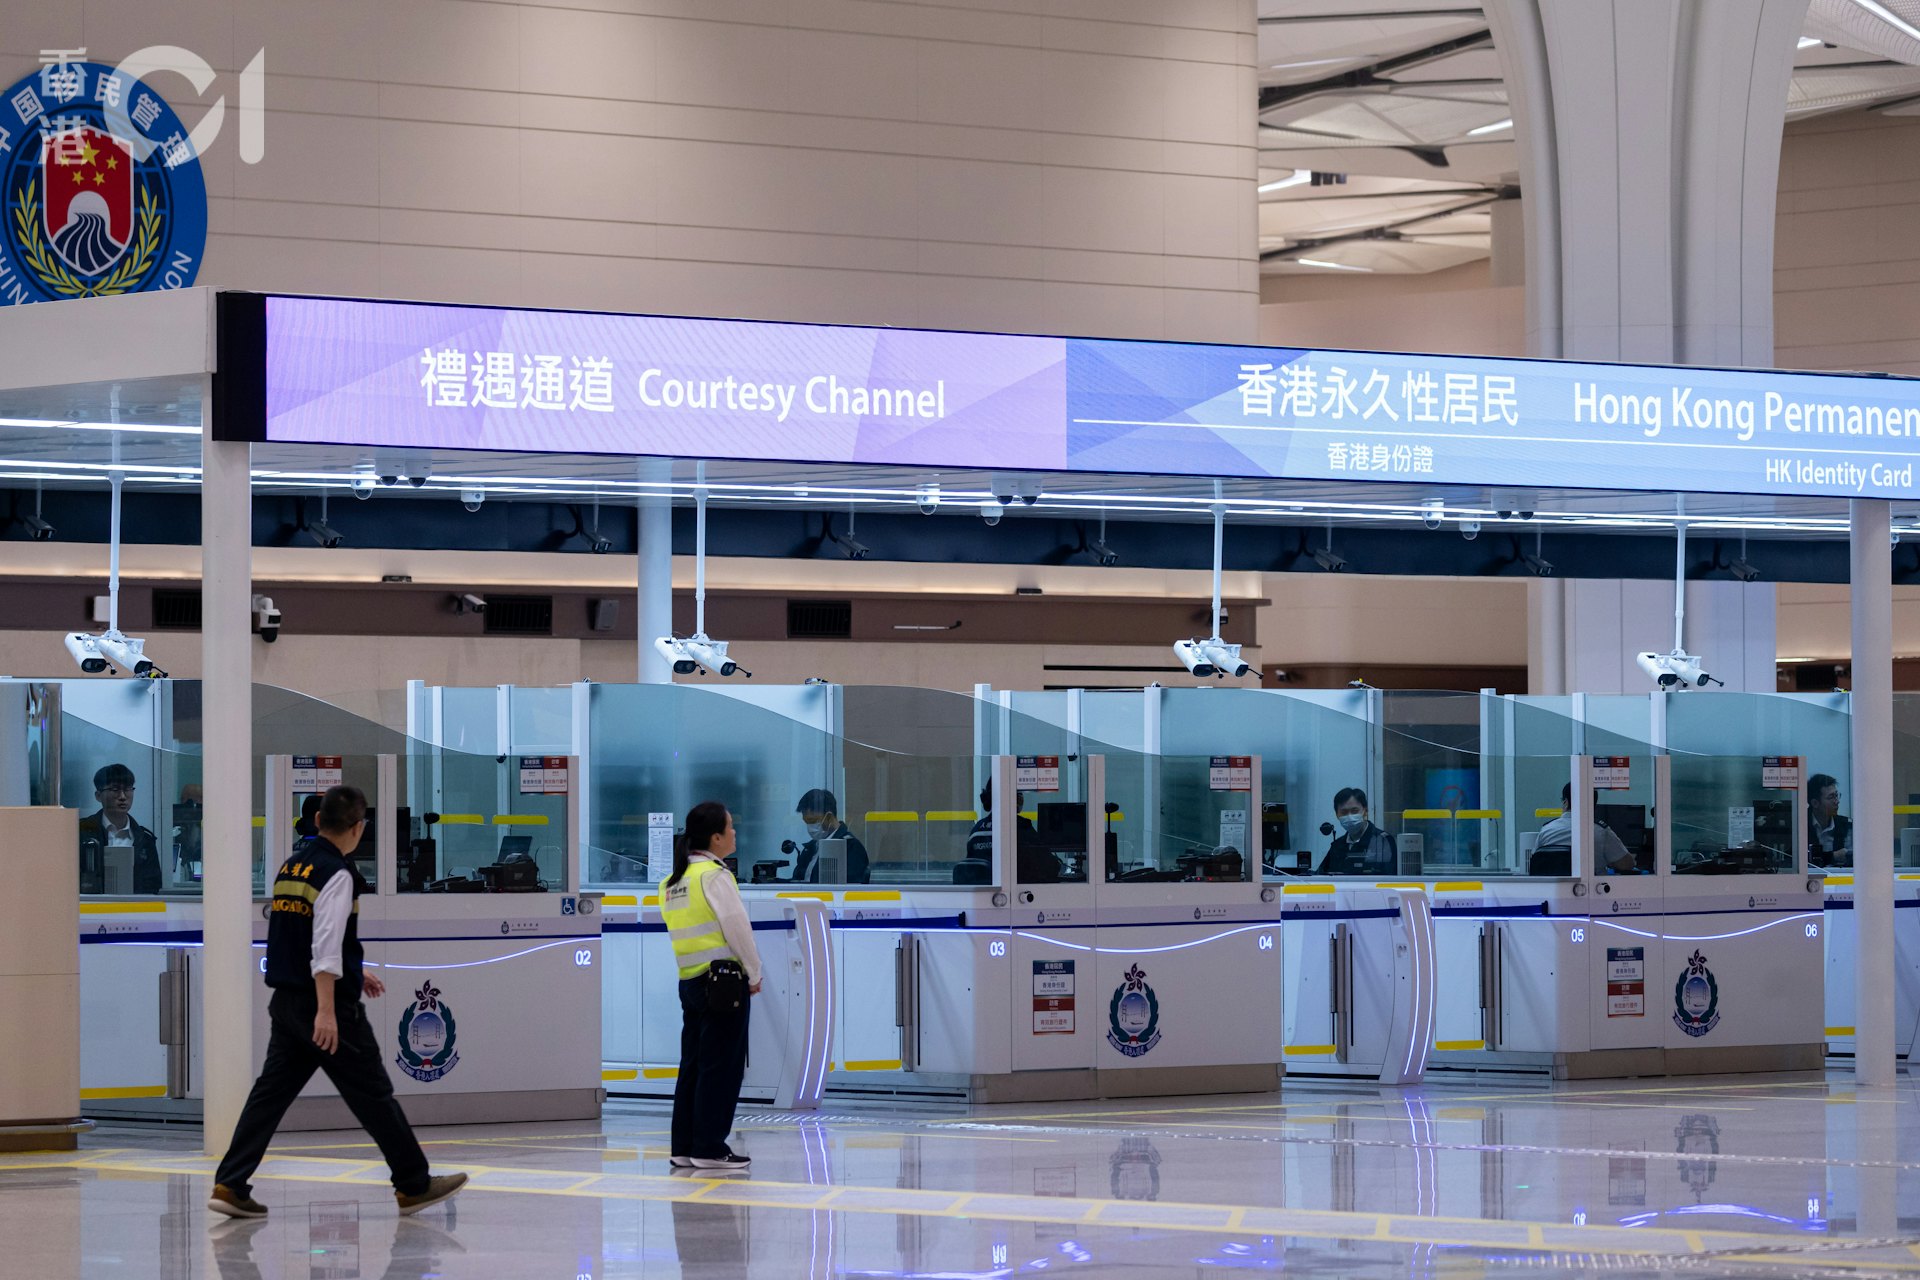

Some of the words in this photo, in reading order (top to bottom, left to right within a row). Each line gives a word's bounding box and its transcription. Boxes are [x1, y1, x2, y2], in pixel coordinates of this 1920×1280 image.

[420, 348, 614, 412] 禮遇通道
[638, 368, 796, 422] Courtesy
[805, 375, 945, 418] Channel
[1237, 363, 1519, 426] 香港永久性居民
[1574, 382, 1661, 437] Hong
[1672, 386, 1754, 441] Kong
[1327, 442, 1434, 473] 香港身份證
[1766, 458, 1792, 483] HK
[1796, 460, 1867, 492] Identity
[1870, 463, 1912, 488] Card
[1258, 935, 1273, 950] 04
[1571, 928, 1585, 943] 05
[1805, 923, 1818, 937] 06
[575, 950, 592, 966] 02
[990, 941, 1005, 956] 03
